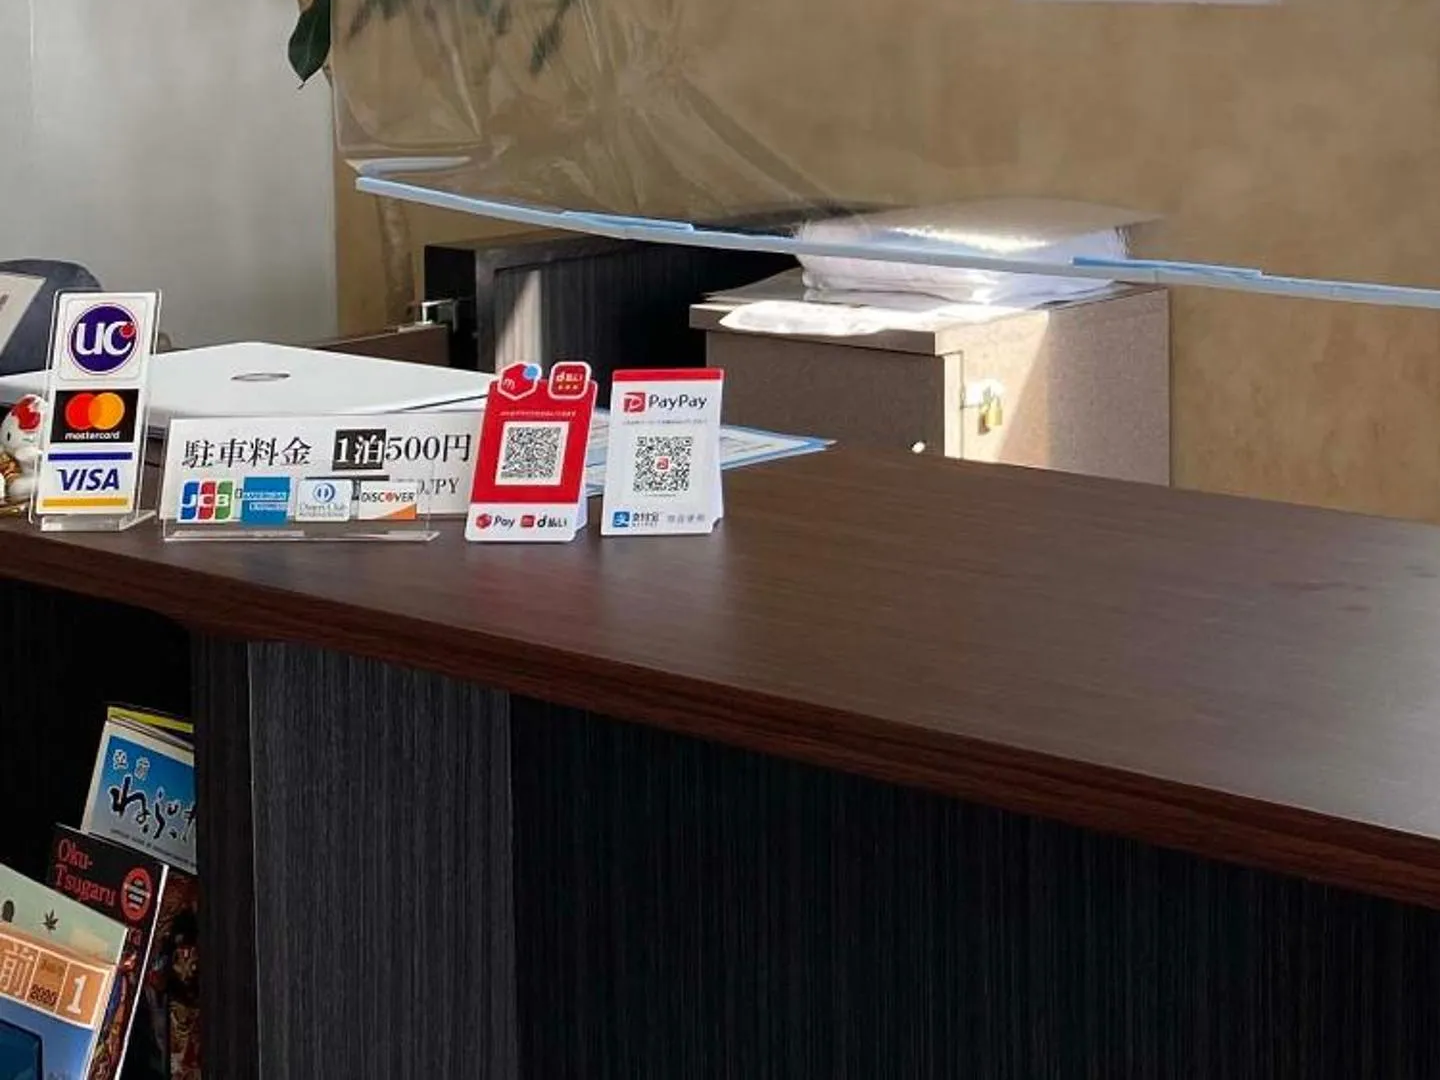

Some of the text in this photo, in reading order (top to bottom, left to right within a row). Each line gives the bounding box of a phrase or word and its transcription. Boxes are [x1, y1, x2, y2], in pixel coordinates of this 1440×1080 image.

[649, 393, 708, 410] PayPay
[64, 431, 121, 441] mastercard
[181, 430, 472, 469] 駐車料金 1泊500円
[57, 468, 121, 492] VISA
[361, 491, 416, 503] DISCOVER
[55, 864, 117, 908] Tsugaru
[66, 973, 88, 1016] 1
